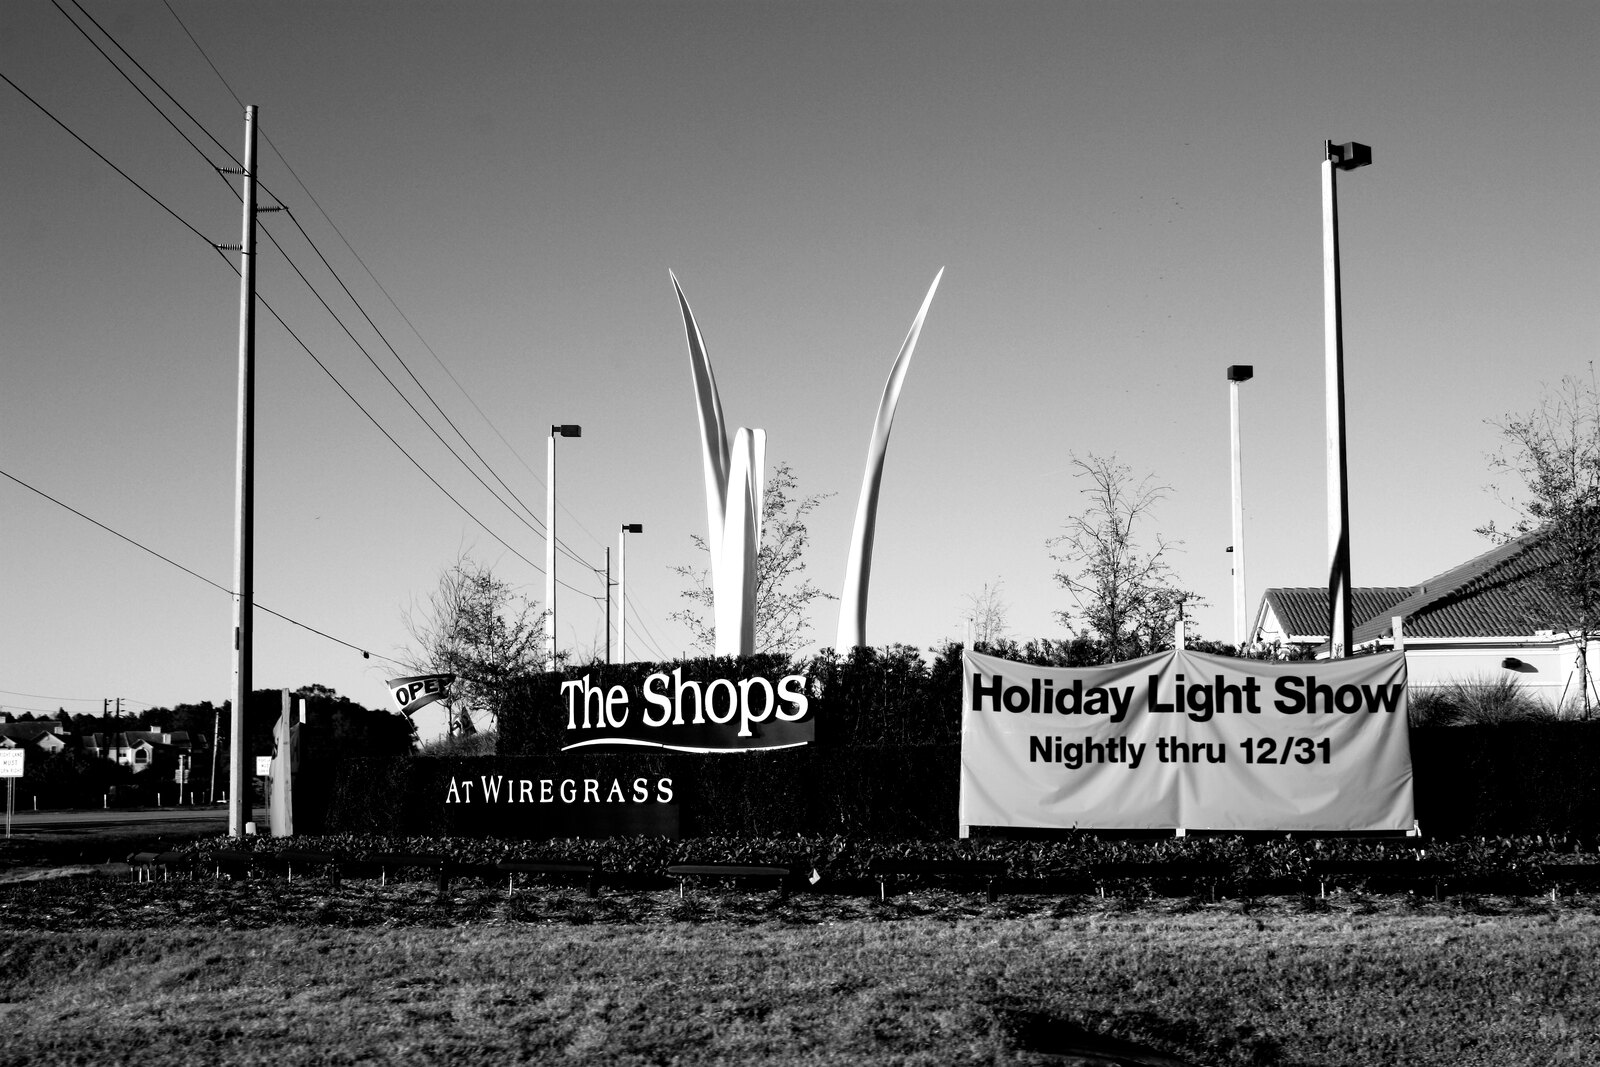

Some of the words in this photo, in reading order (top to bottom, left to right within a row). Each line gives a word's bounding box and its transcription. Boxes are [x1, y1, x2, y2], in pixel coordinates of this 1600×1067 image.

[560, 673, 629, 730] The
[642, 667, 809, 737] Shops
[972, 673, 1135, 723] Holiday
[1147, 673, 1261, 723] Light
[1274, 674, 1400, 715] Show
[1030, 735, 1146, 770] Nightly
[1156, 736, 1226, 764] thru
[1240, 736, 1331, 765] 12/31
[445, 776, 474, 803] AT
[481, 775, 673, 803] WIREGRASS
